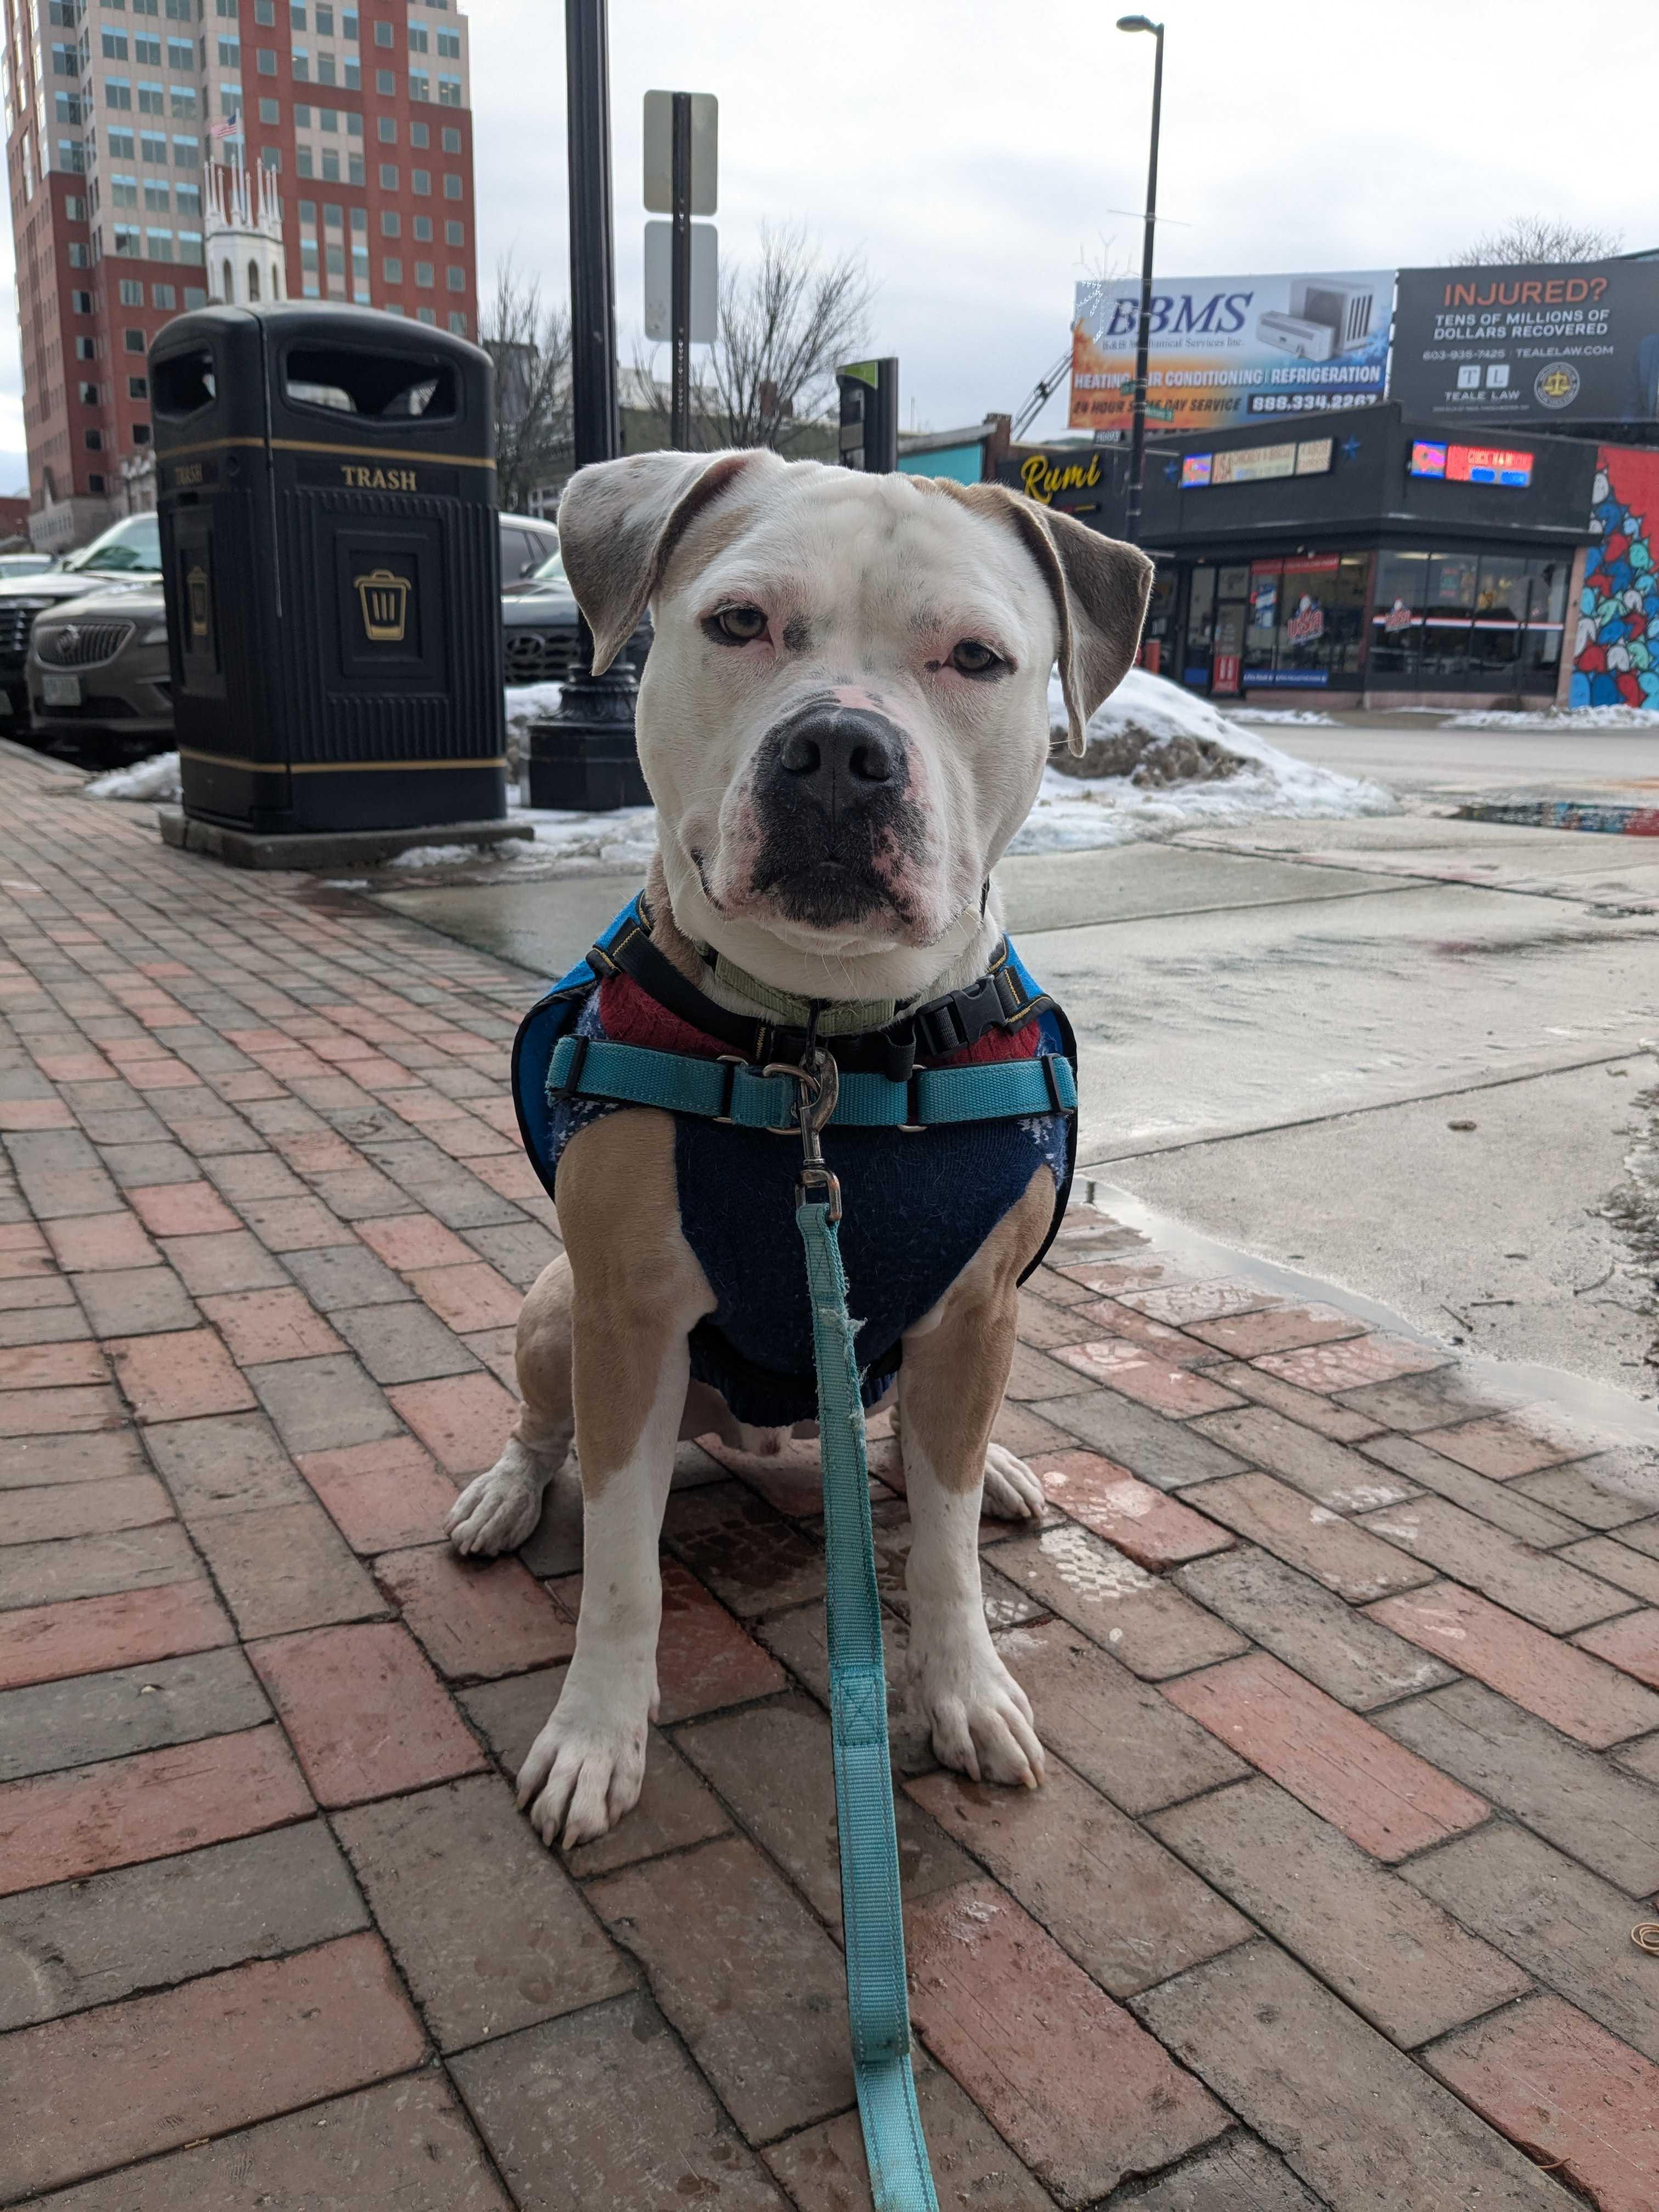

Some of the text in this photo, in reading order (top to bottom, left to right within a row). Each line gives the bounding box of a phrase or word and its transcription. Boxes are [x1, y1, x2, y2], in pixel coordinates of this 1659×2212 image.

[1444, 277, 1607, 306] INJURED?
[1106, 291, 1255, 335] BBMS
[1435, 309, 1610, 327] TENS OF MILLIONS OF
[1434, 323, 1608, 340] DOLLARS RECOVERED
[1516, 346, 1614, 357] TEALELAW.COM
[1165, 369, 1263, 386] CONDITIONING
[1271, 365, 1381, 383] REFRIGERATION
[1444, 390, 1520, 401] TEALE LAW
[1092, 400, 1125, 413] HOUR
[1189, 398, 1242, 411] SERVICE
[341, 465, 417, 491] TRASH
[1020, 453, 1101, 504] Rumi
